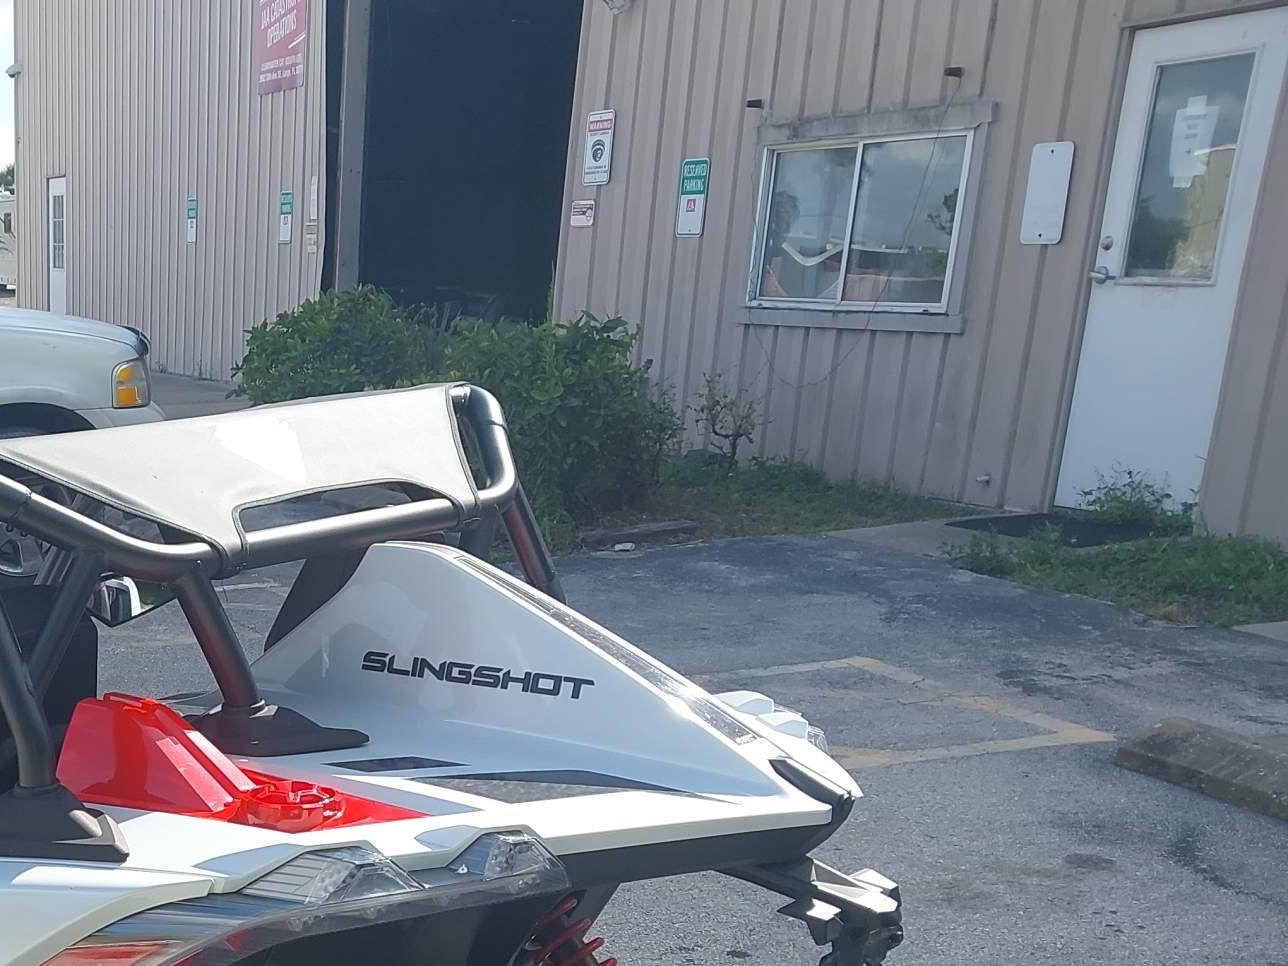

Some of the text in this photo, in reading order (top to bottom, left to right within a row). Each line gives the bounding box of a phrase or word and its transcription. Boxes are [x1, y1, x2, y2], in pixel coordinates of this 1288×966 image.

[266, 9, 297, 48] OPERATIONS
[589, 120, 611, 131] WARNING
[683, 163, 707, 178] RESERVED
[683, 178, 704, 192] PARKING
[362, 651, 595, 699] SLINGSHOT
